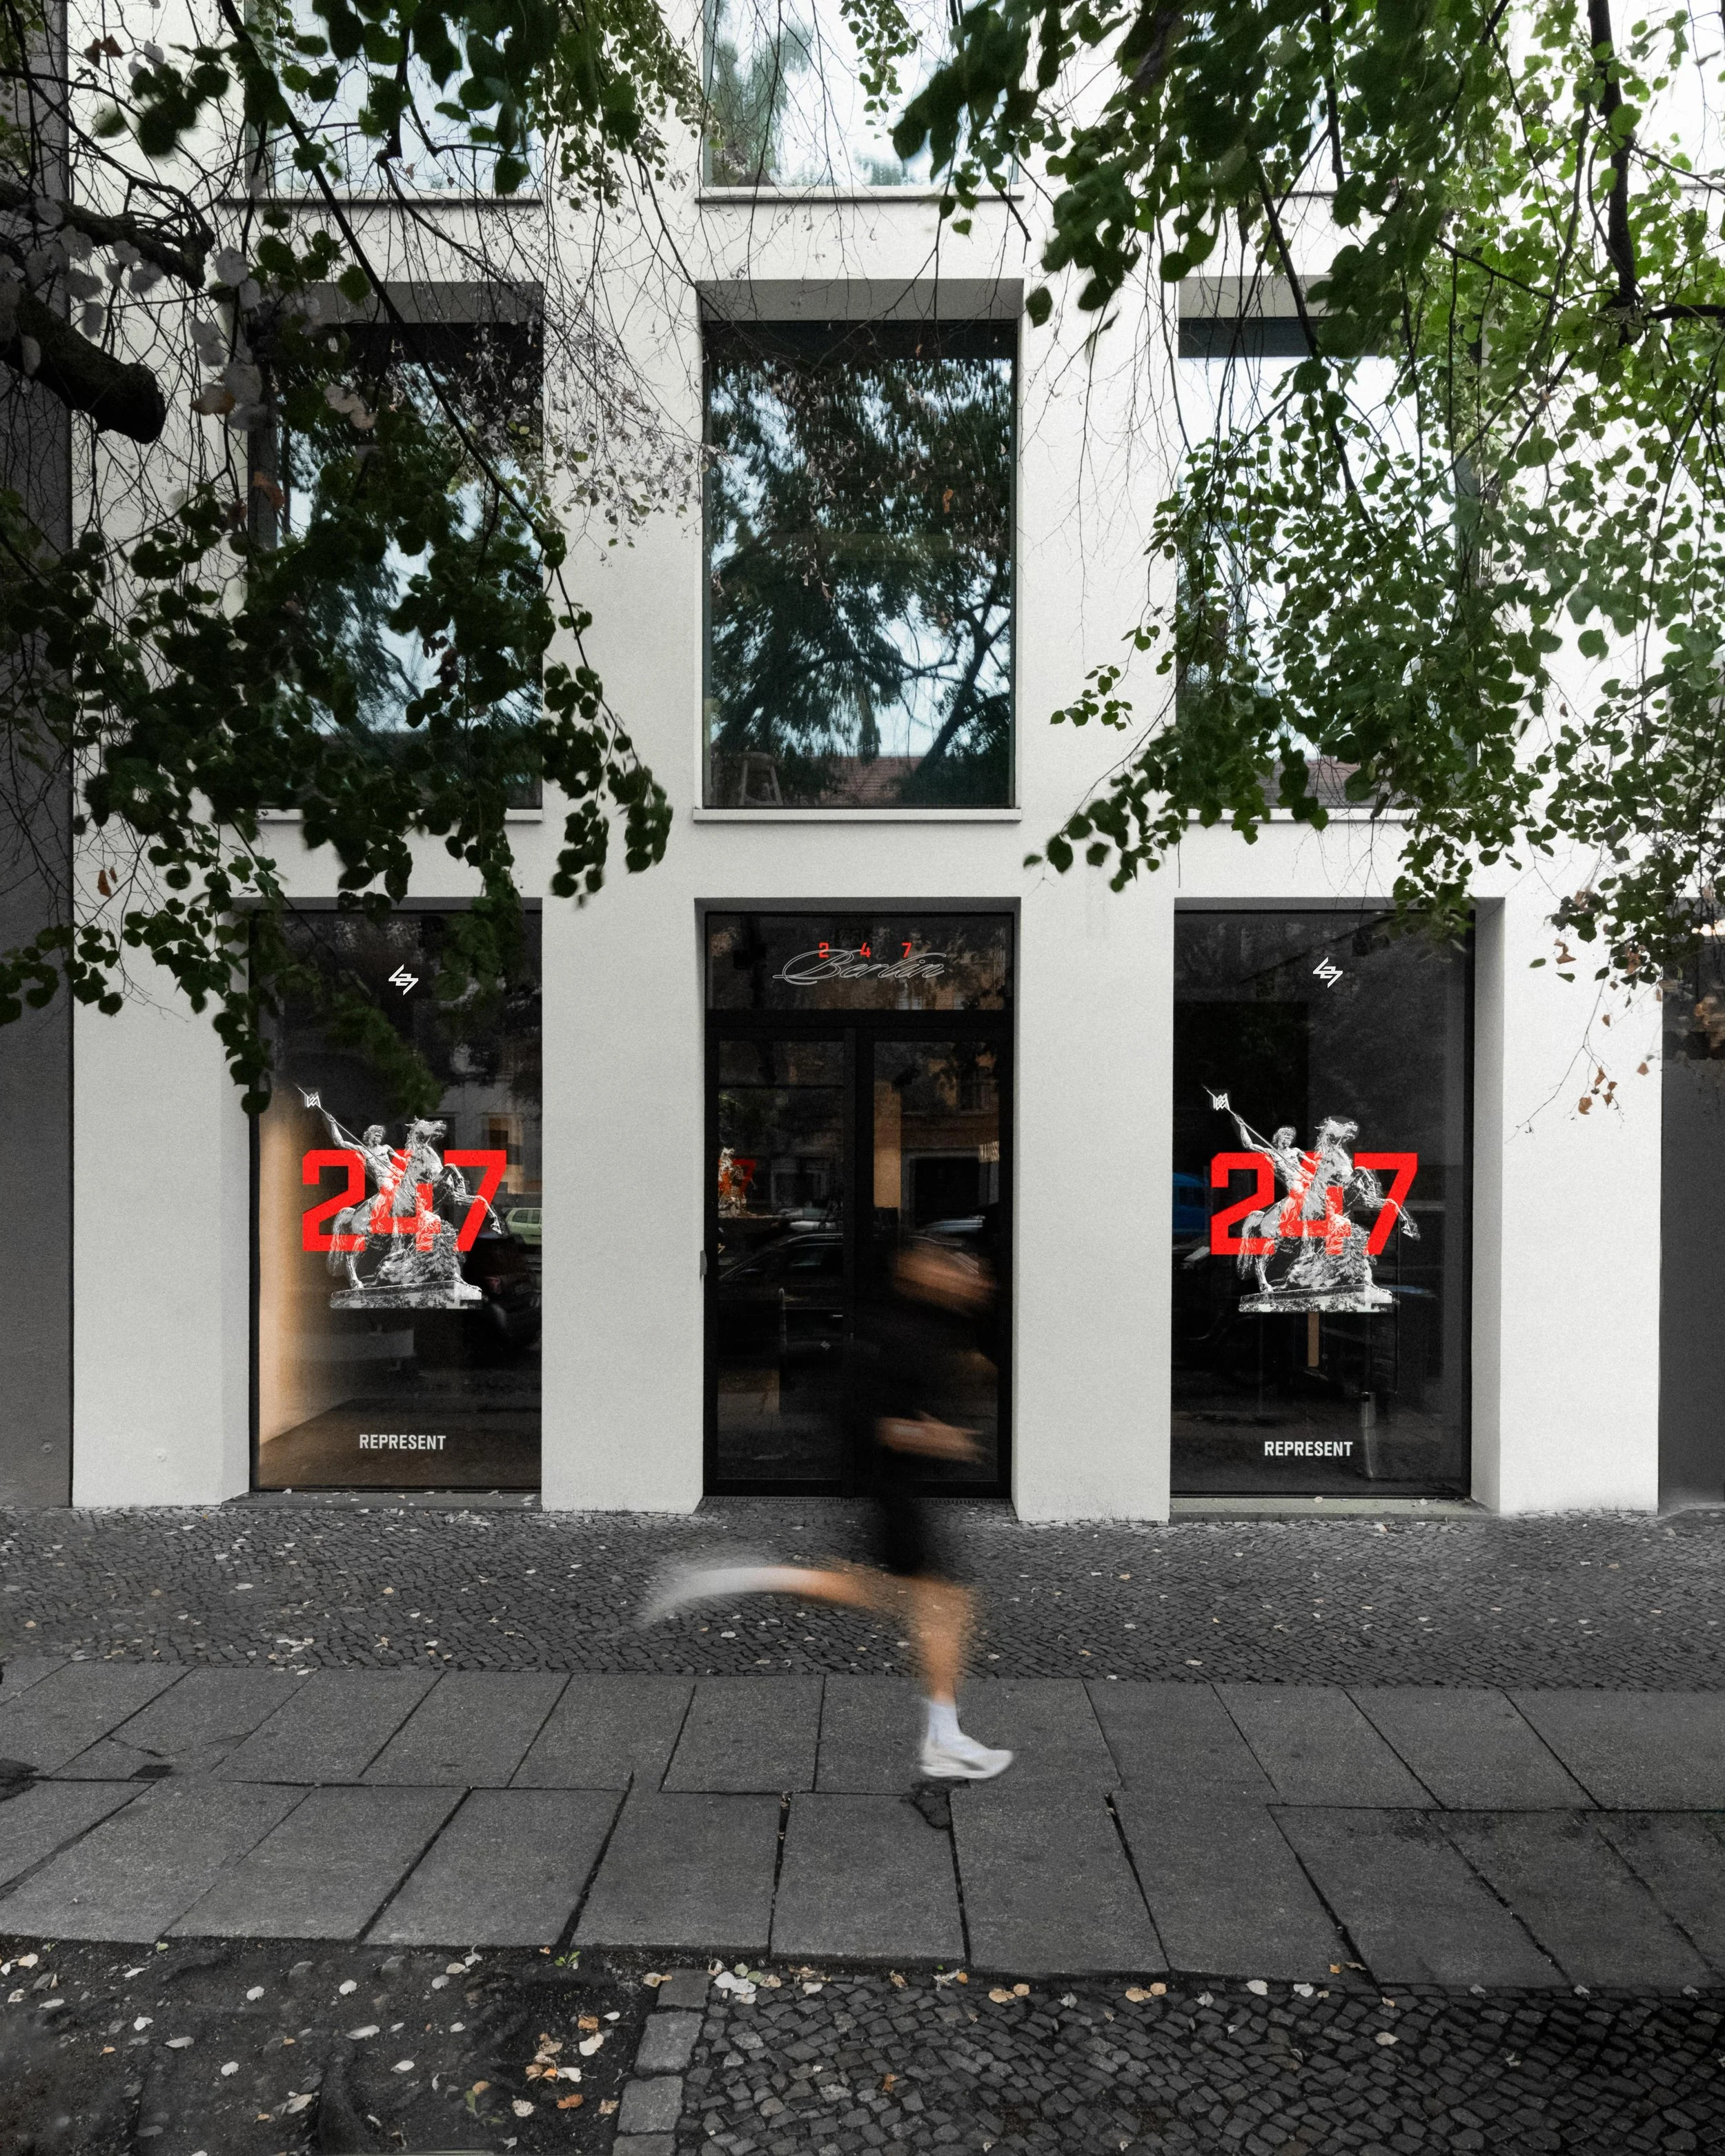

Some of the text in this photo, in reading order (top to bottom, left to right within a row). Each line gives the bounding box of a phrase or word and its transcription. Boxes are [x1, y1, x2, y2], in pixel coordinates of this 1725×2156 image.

[773, 949, 947, 985] Berlin
[302, 1149, 507, 1252] 247
[1210, 1152, 1419, 1255] 247
[359, 1434, 446, 1450] REPRESENT
[1264, 1441, 1353, 1456] REPRESENT
